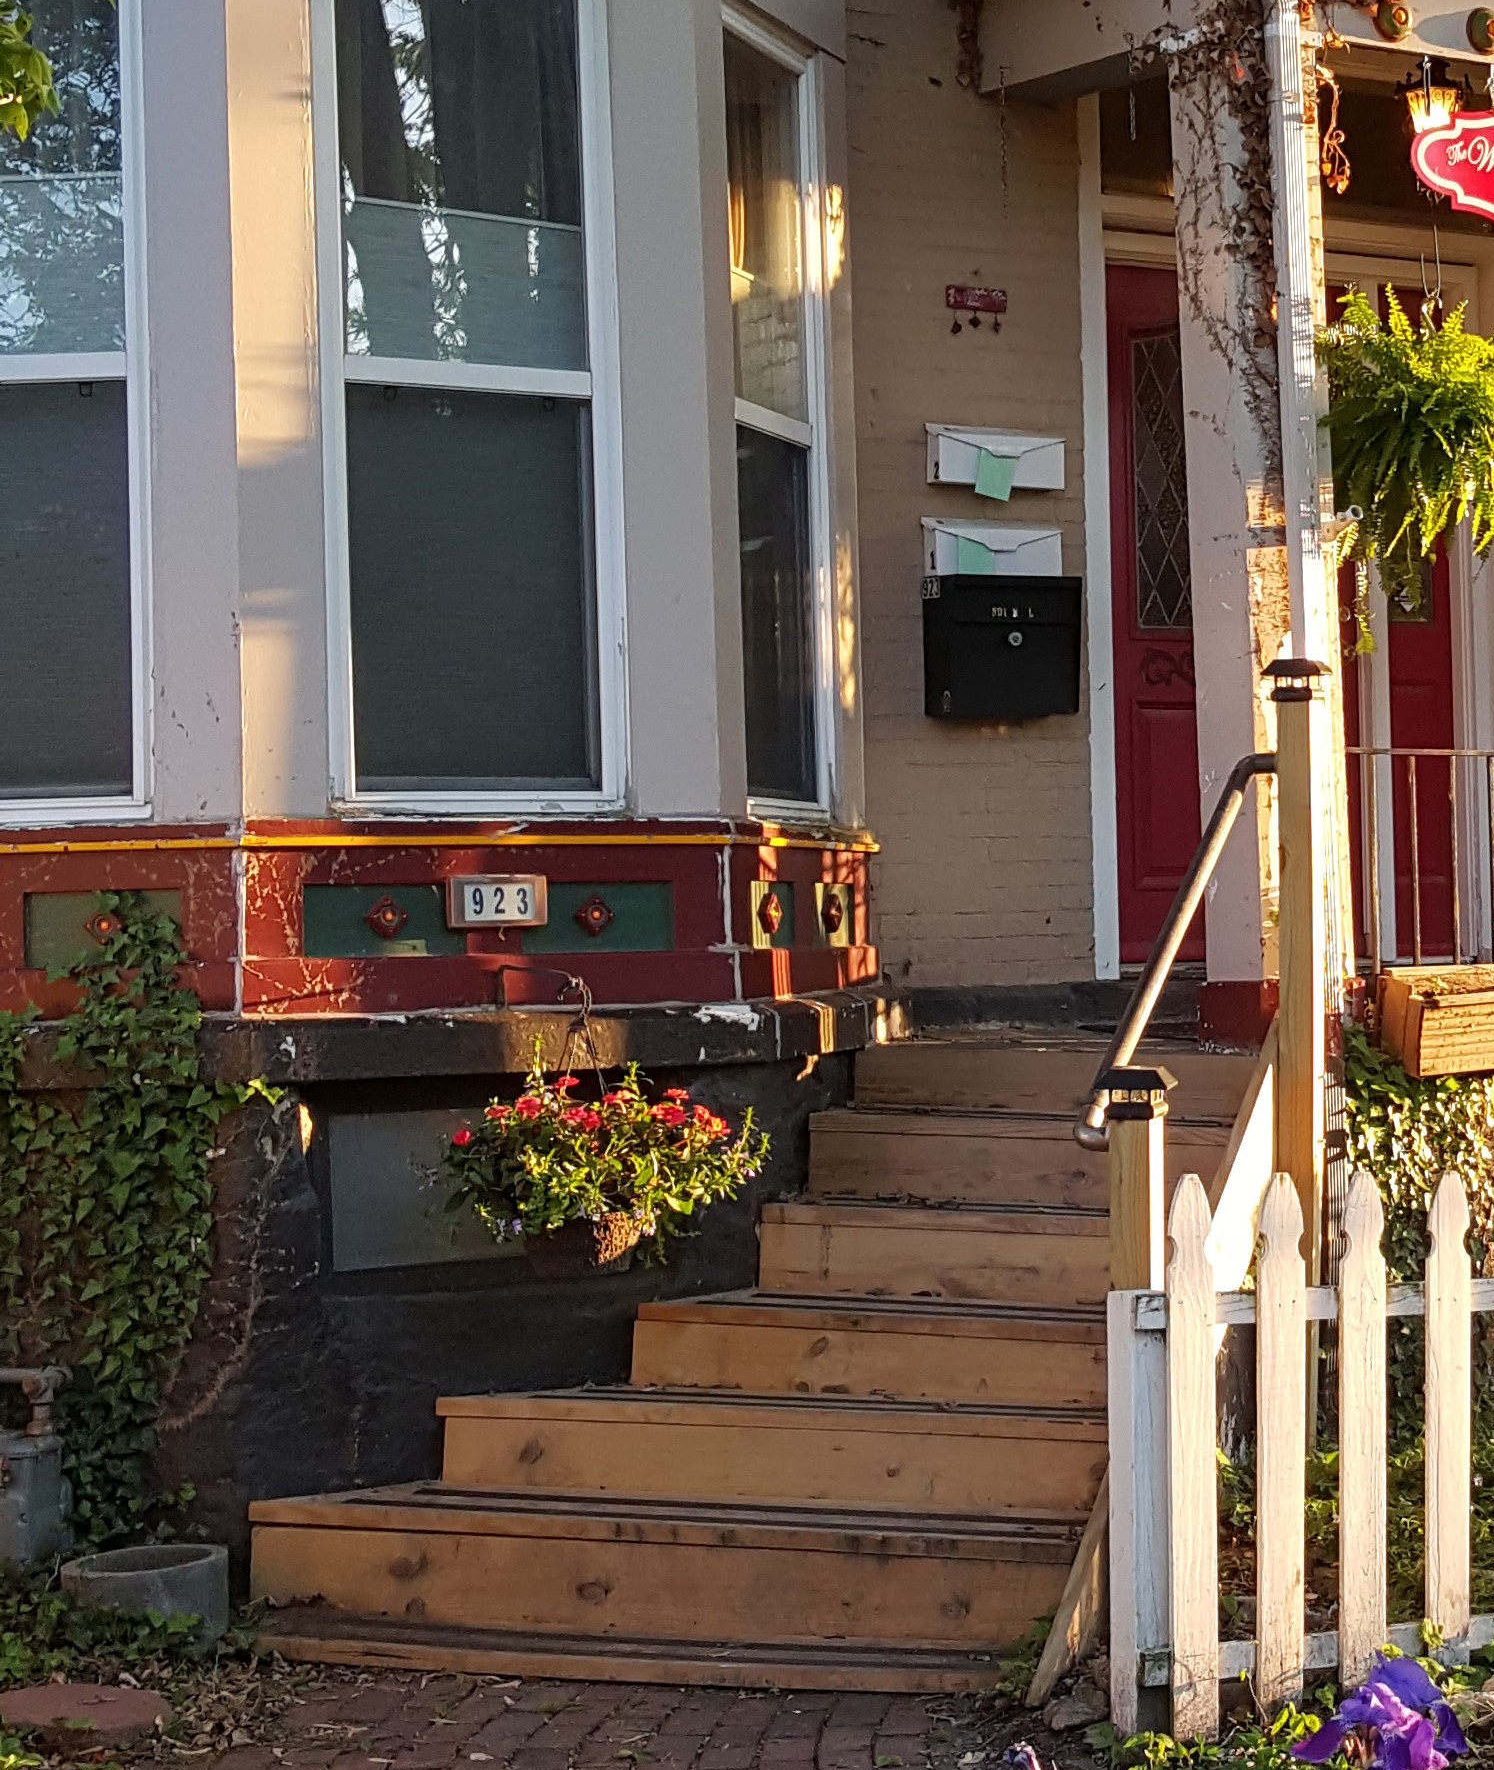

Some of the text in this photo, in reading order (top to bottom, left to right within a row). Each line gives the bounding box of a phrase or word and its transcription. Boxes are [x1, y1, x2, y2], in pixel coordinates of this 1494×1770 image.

[1446, 140, 1468, 166] The
[933, 461, 940, 480] 2
[930, 550, 936, 570] 1
[922, 578, 940, 598] 923
[472, 887, 529, 916] 923
